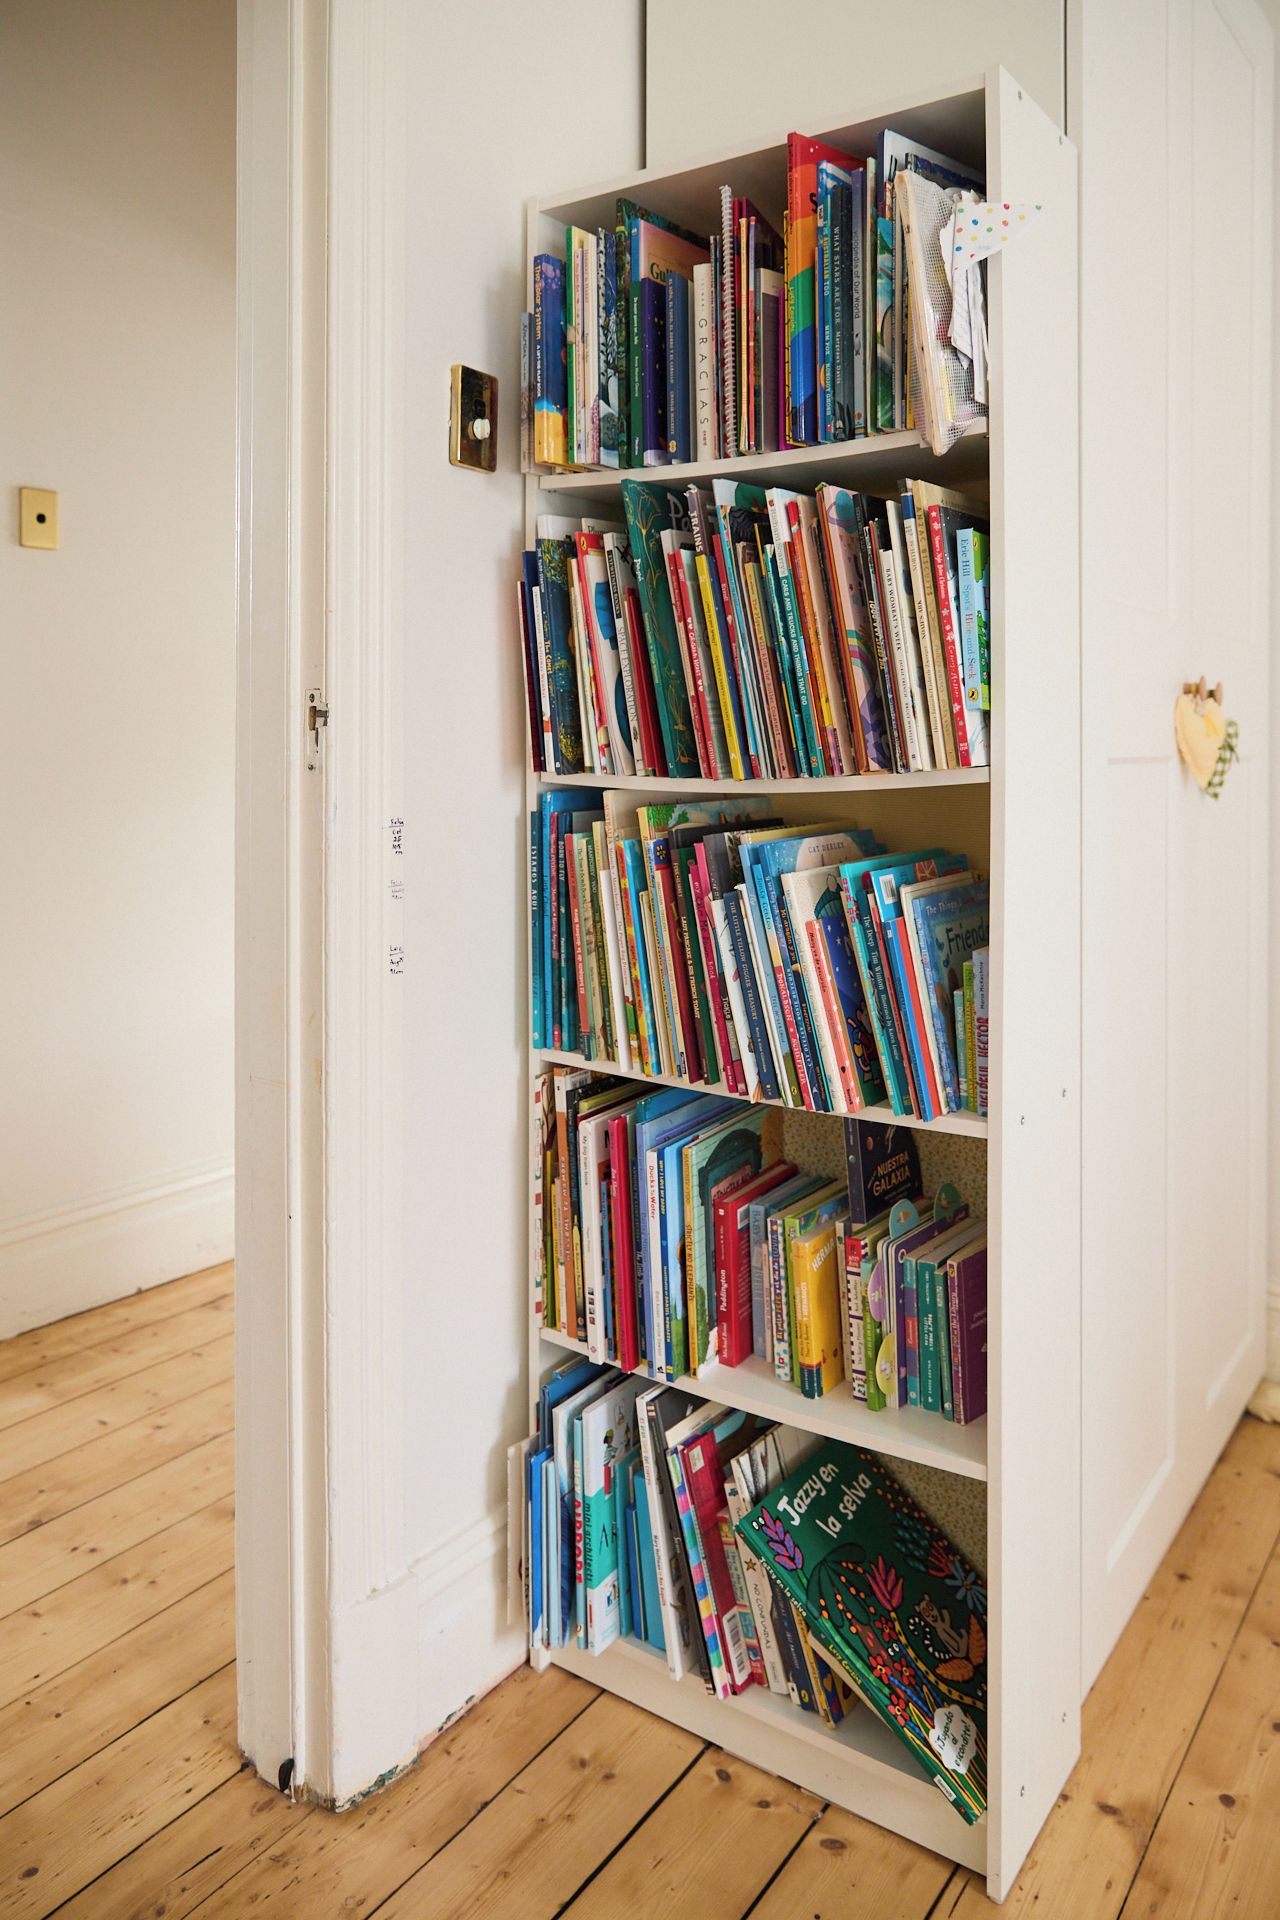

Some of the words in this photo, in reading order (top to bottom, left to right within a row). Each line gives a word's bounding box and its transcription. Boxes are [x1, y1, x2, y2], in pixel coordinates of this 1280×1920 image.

[534, 306, 542, 340] System
[698, 318, 709, 424] GRACIAS
[688, 510, 704, 552] TRAINS
[915, 506, 926, 542] ANZAC
[960, 538, 969, 558] Eric
[884, 568, 893, 586] BABY
[920, 548, 933, 596] BISCUITS
[961, 560, 970, 576] Hill
[781, 578, 790, 596] CARS
[962, 584, 972, 610] Spot's
[784, 598, 792, 610] AND
[887, 588, 899, 630] WOMBAT'S
[786, 612, 797, 638] TRUCKS
[616, 626, 628, 654] SPACE
[791, 638, 799, 652] AND
[893, 630, 902, 652] WEEK
[963, 612, 977, 680] Hide-and-Seek
[545, 654, 553, 674] Comet
[793, 654, 803, 676] THINGS
[619, 656, 639, 722] EXPLORATION
[797, 678, 806, 694] THAT
[800, 694, 808, 706] GO
[808, 844, 820, 854] CAT
[822, 842, 845, 852] DEELEY
[558, 860, 564, 868] TO
[728, 902, 736, 912] THE
[760, 902, 772, 930] Gentoo
[731, 914, 741, 936] LITTLE
[862, 916, 872, 928] The
[945, 916, 989, 954] Friend
[682, 932, 692, 958] PANCAKE
[736, 938, 746, 962] YELLOW
[863, 930, 876, 946] Deep
[870, 952, 880, 964] Tim
[688, 976, 698, 998] FRENCH
[741, 964, 751, 986] DIGGER
[873, 966, 886, 990] Winton
[692, 1000, 700, 1018] TOAST
[746, 988, 758, 1020] TREASURY
[775, 972, 793, 1020] DONALDSON
[790, 1038, 807, 1084] SCHEFFLER
[976, 1016, 989, 1058] HECTOR
[876, 1152, 910, 1176] NUESTRA
[872, 1166, 912, 1196] GALAXIA
[649, 1196, 657, 1220] Water
[685, 1224, 693, 1250] STRICTLY
[686, 1252, 693, 1262] NO
[687, 1264, 695, 1302] ELEPHANTS
[719, 1268, 728, 1312] Paddington
[777, 1474, 824, 1526] Jazzy
[820, 1464, 839, 1482] en
[815, 1516, 842, 1538] la
[839, 1474, 872, 1520] selva
[584, 1502, 592, 1526] mini
[574, 1498, 583, 1584] AIRPORT
[585, 1530, 593, 1582] architects
[753, 1584, 761, 1596] NO
[759, 1556, 777, 1580] Jazzy
[776, 1578, 784, 1588] en
[784, 1586, 791, 1596] la
[790, 1596, 808, 1617] selva
[756, 1598, 771, 1649] CONFUNDAS
[935, 1710, 954, 1750] ¡Jugando
[954, 1720, 971, 1766] escondite!
